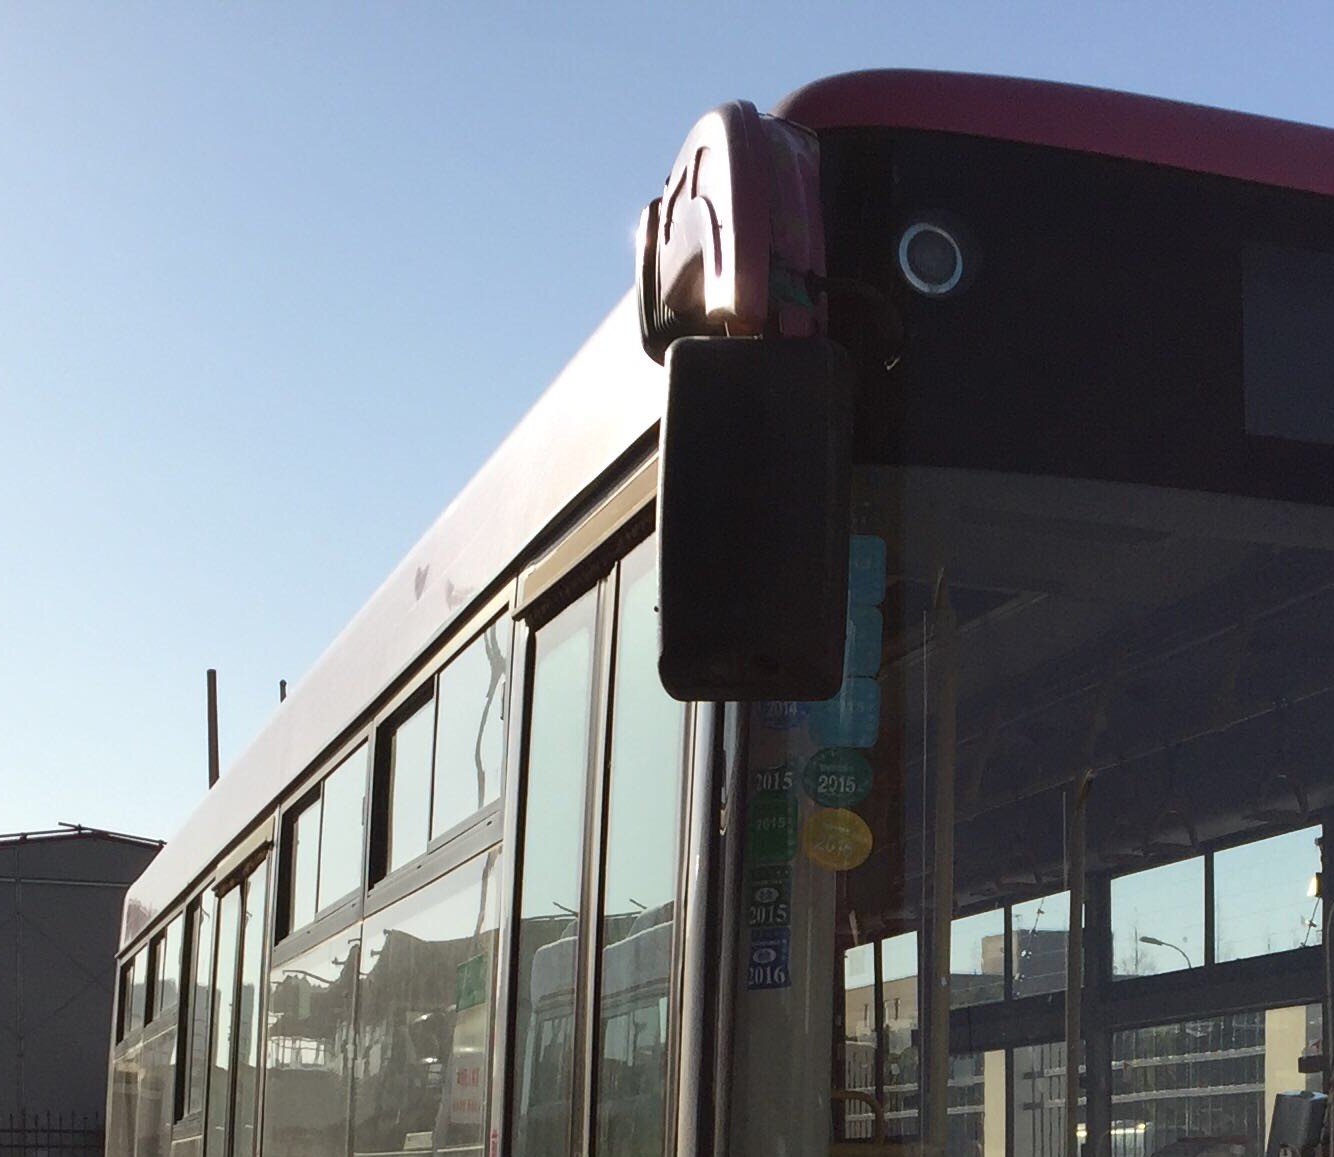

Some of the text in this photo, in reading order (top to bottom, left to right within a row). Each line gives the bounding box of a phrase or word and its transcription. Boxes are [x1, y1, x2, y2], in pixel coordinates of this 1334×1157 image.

[816, 774, 858, 794] 2015
[748, 903, 788, 927] 2015
[747, 964, 786, 986] 2016
